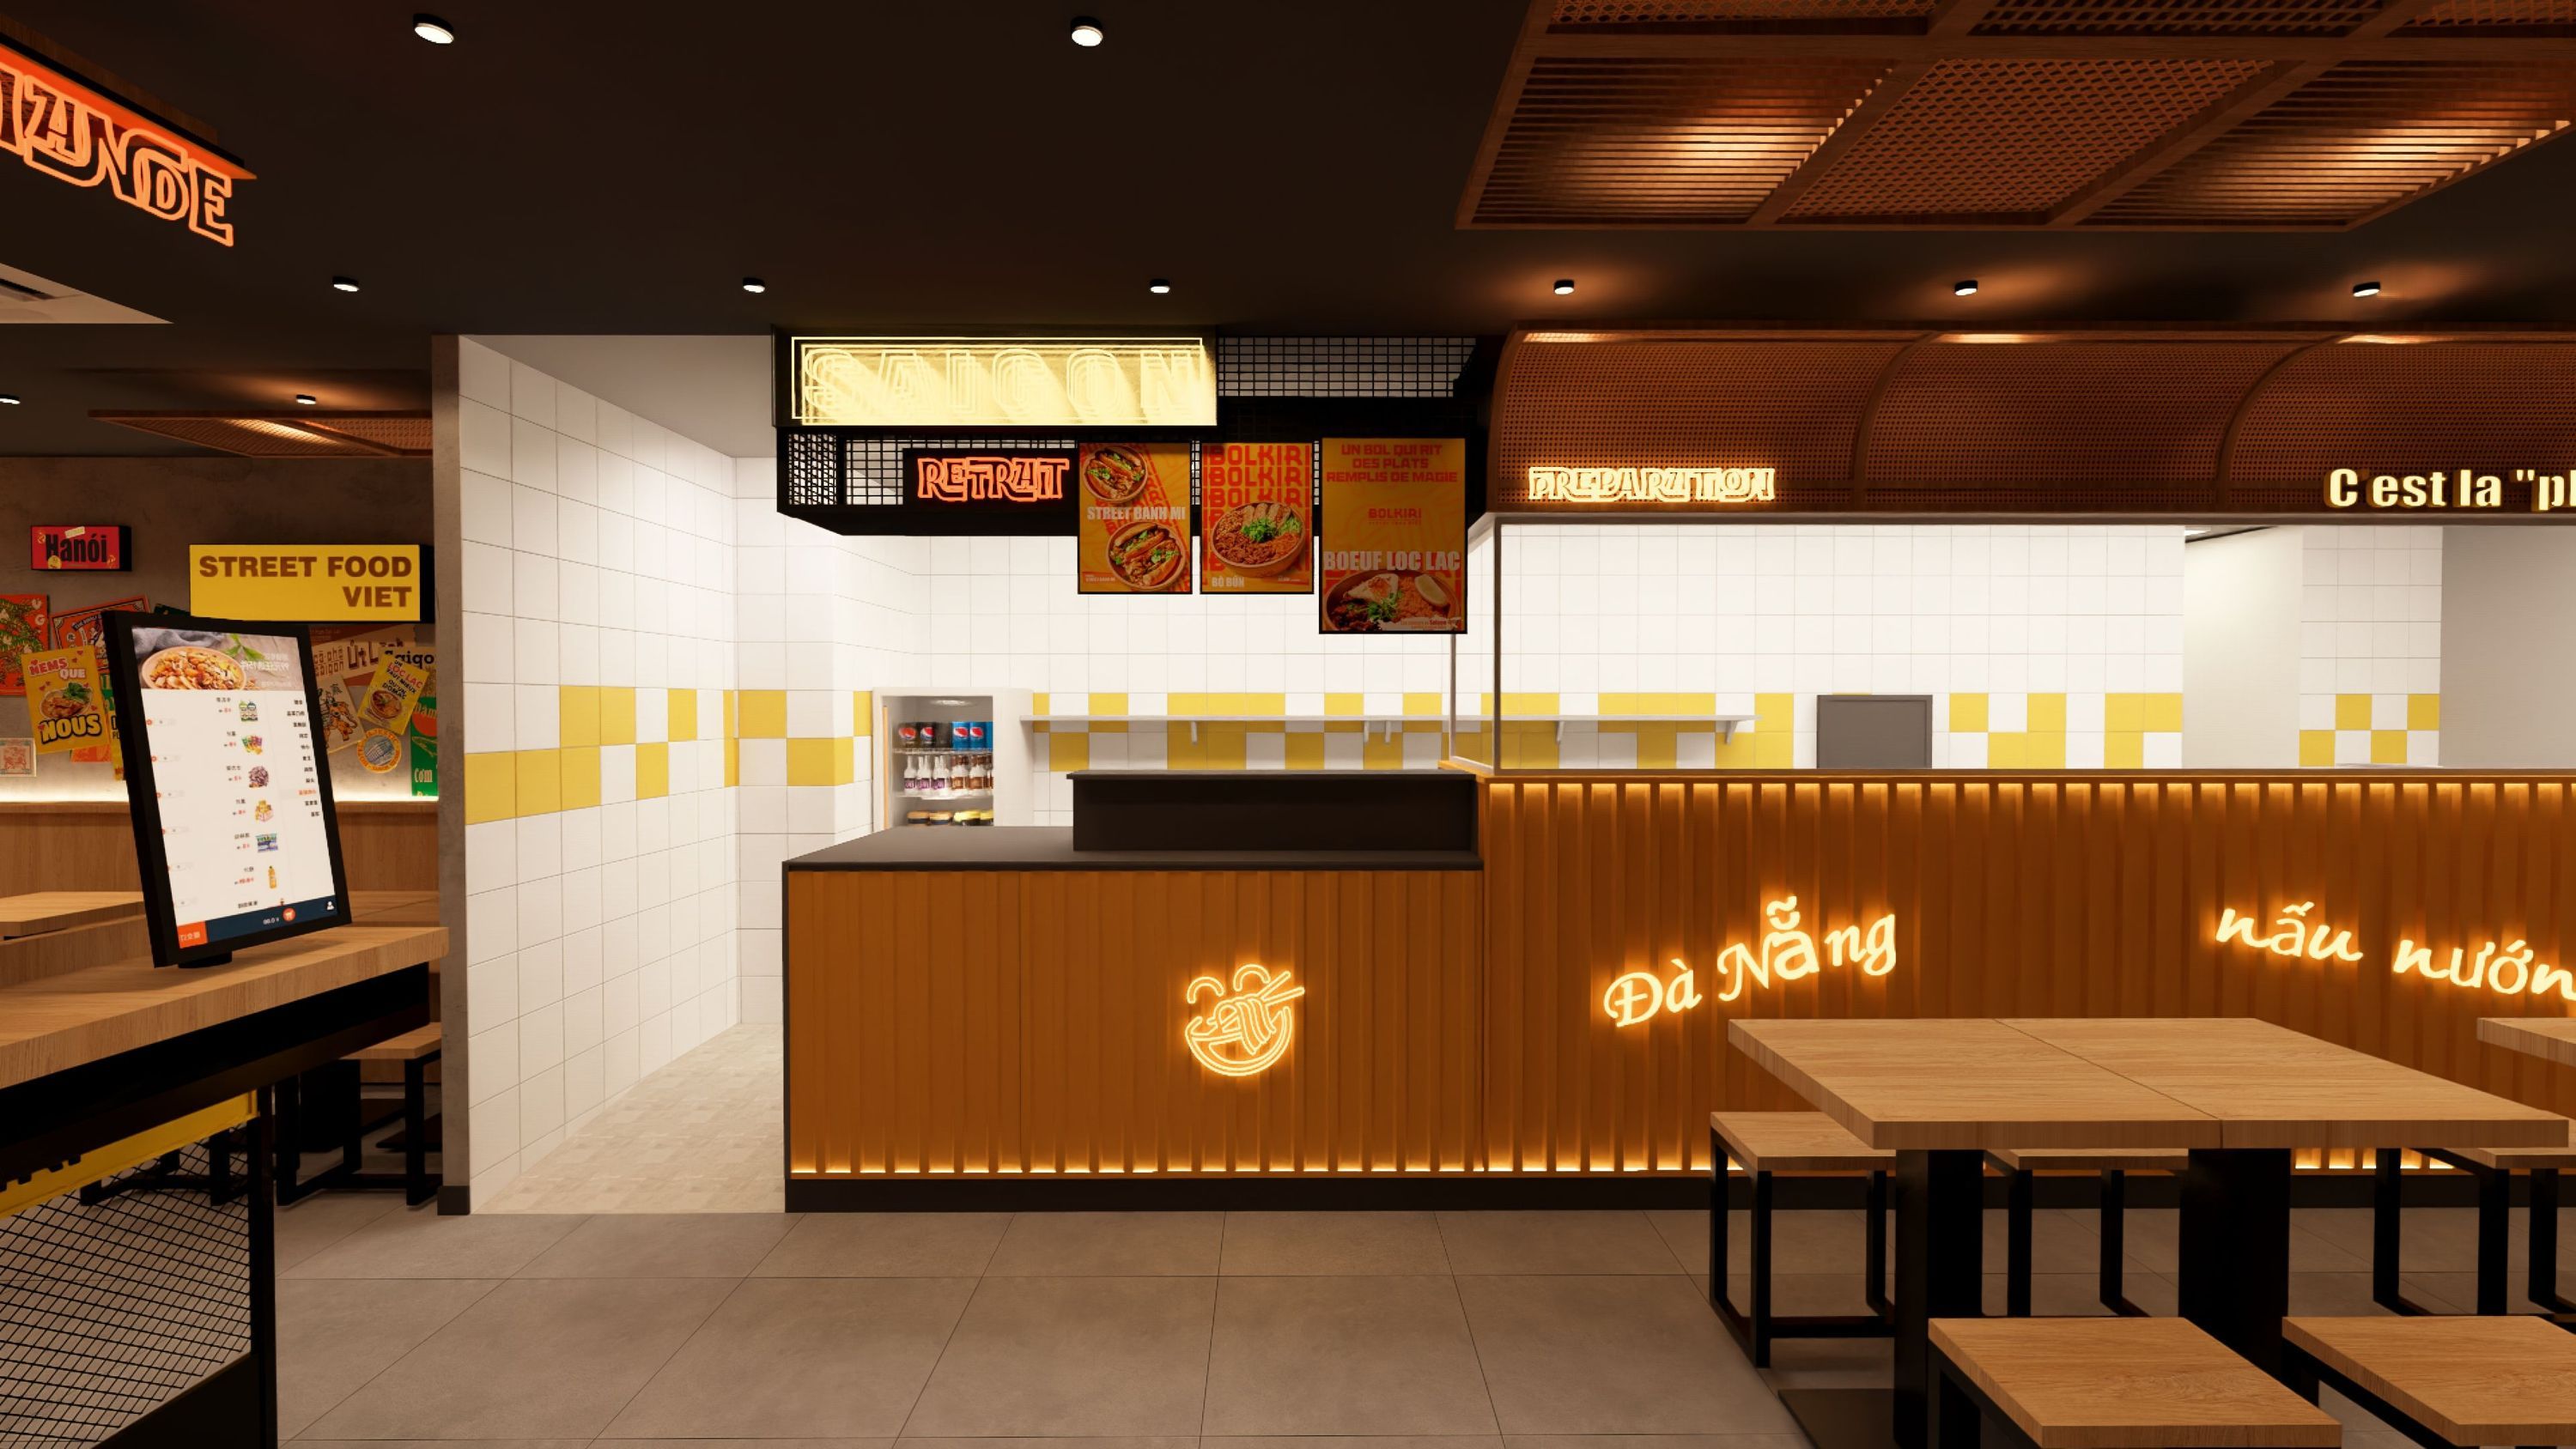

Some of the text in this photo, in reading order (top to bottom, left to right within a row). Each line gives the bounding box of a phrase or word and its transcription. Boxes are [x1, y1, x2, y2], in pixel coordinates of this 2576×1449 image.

[804, 348, 1194, 415] SAIGON
[1209, 446, 1310, 465] BOLKIRI
[1341, 444, 1443, 457] UN BOL QUI RIT
[1352, 458, 1429, 469] DES PLATS
[917, 457, 1070, 501] RETRAIT
[1209, 467, 1310, 487] BOLKIRI
[1327, 471, 1458, 482] REMPLIS DE MAGIE
[2460, 470, 2501, 506] la
[1087, 506, 1186, 520] STREET BANH MI
[1368, 508, 1422, 518] BOLKIRI
[199, 555, 412, 578] STREET FOOD
[1323, 550, 1461, 571] BOEUF LOC LAC
[342, 586, 412, 607] VIET
[28, 658, 69, 677] NEMS
[59, 667, 86, 679] QUE
[405, 675, 423, 689] LAC
[40, 714, 102, 744] NOUS
[2215, 901, 2364, 962] nấu
[1603, 959, 1704, 1028] Đà
